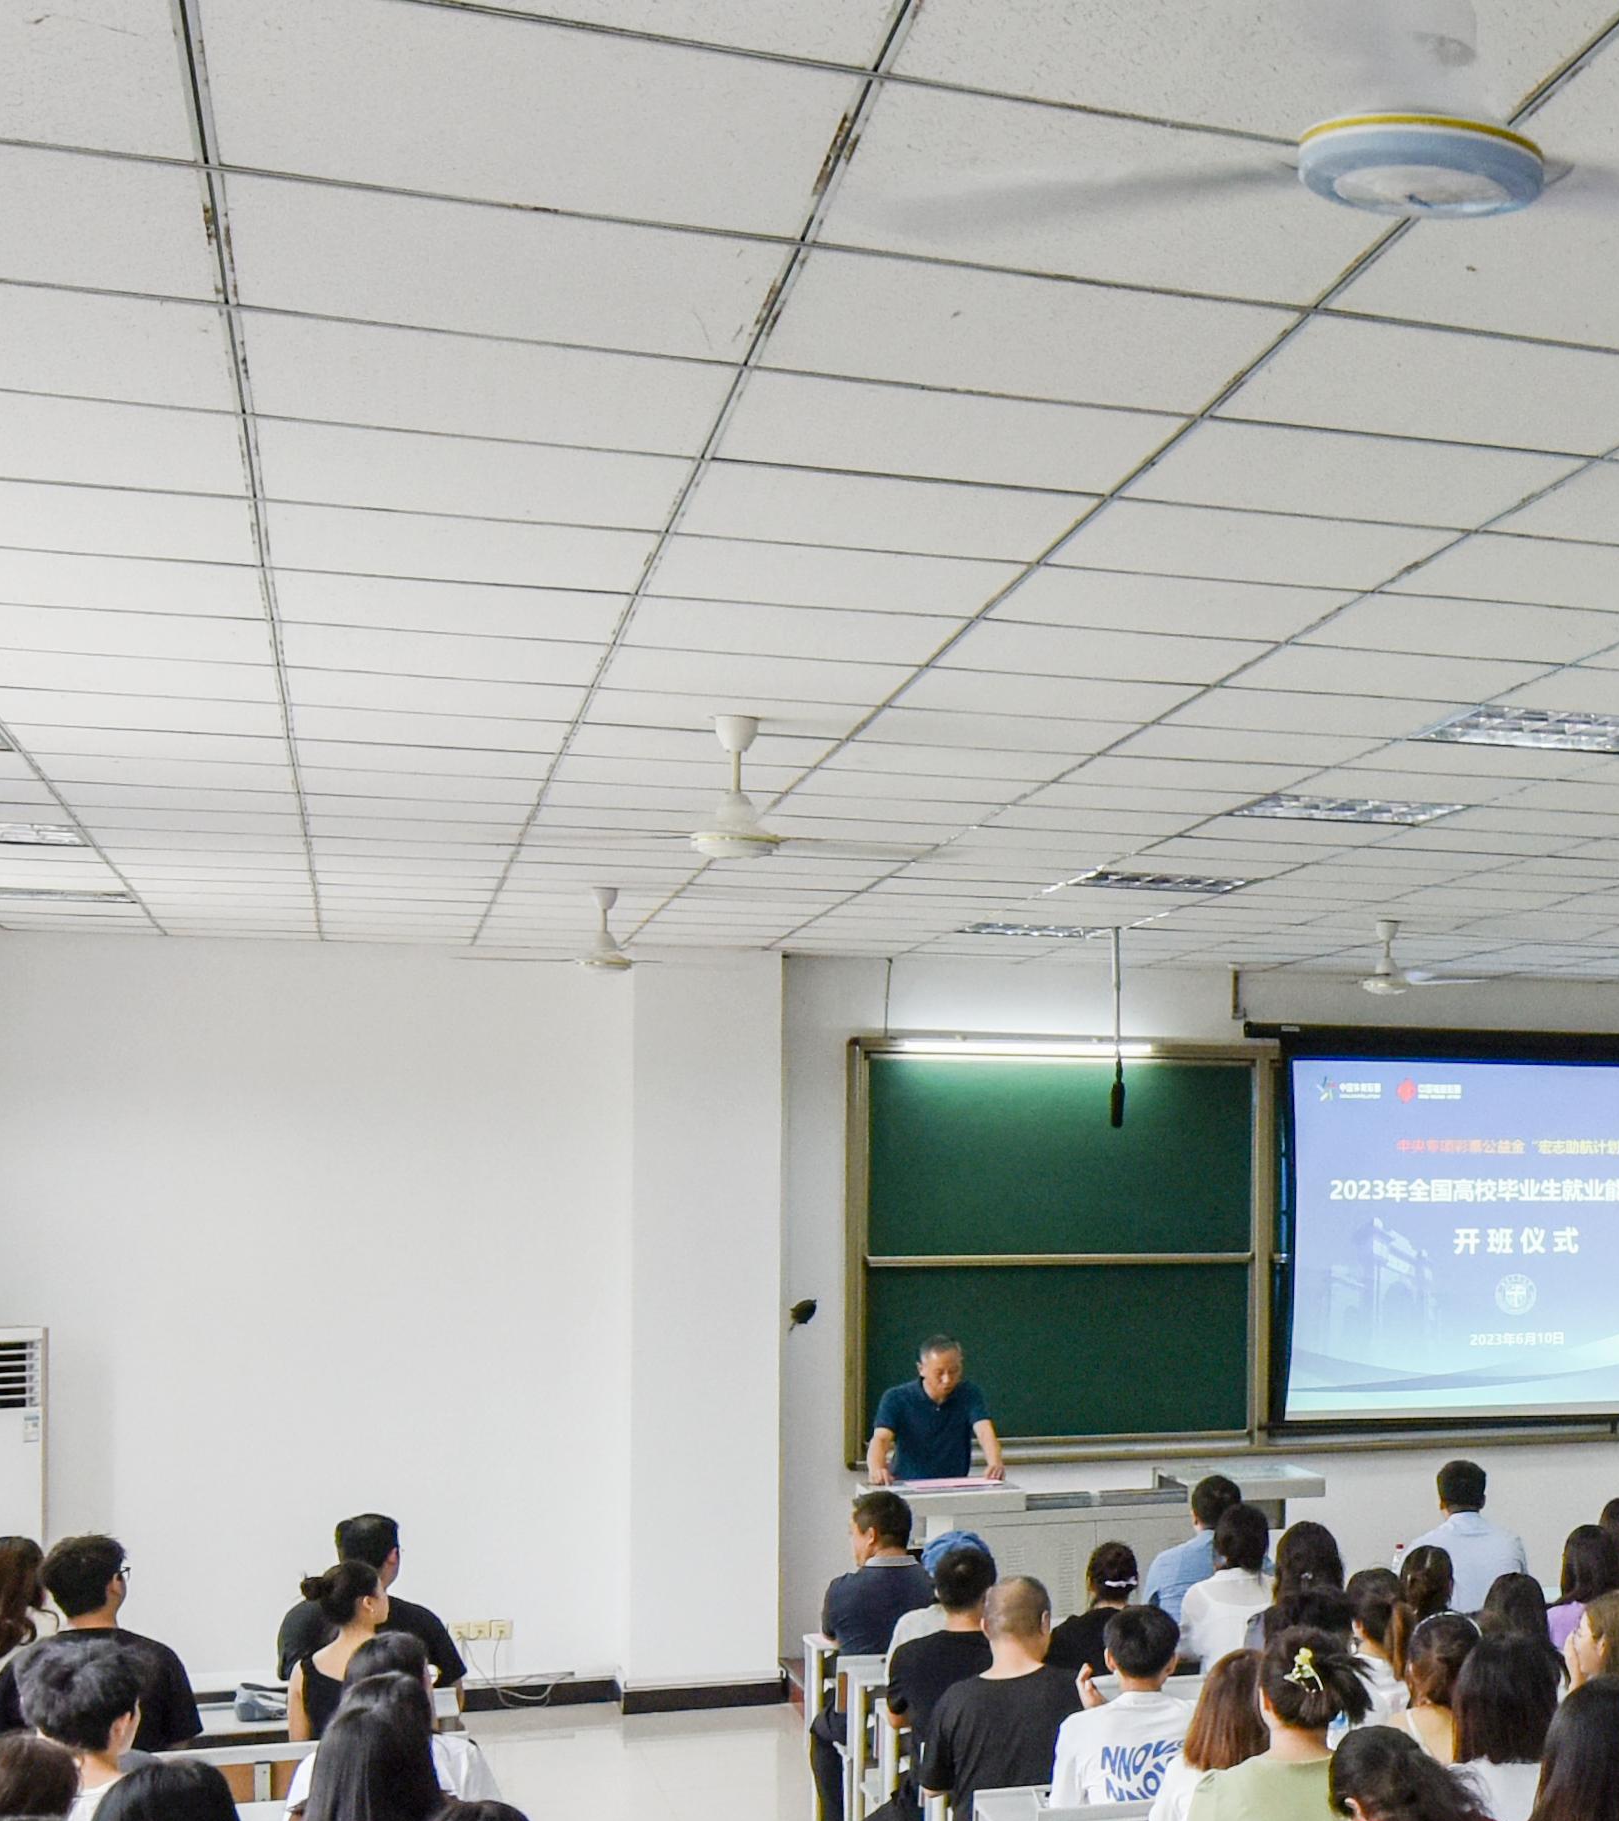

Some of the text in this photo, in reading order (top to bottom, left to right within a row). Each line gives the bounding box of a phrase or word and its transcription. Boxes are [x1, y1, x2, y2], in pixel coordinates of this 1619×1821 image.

[1452, 1226, 1580, 1255] 开班仪式
[1469, 1331, 1565, 1347] 2023年6月10日
